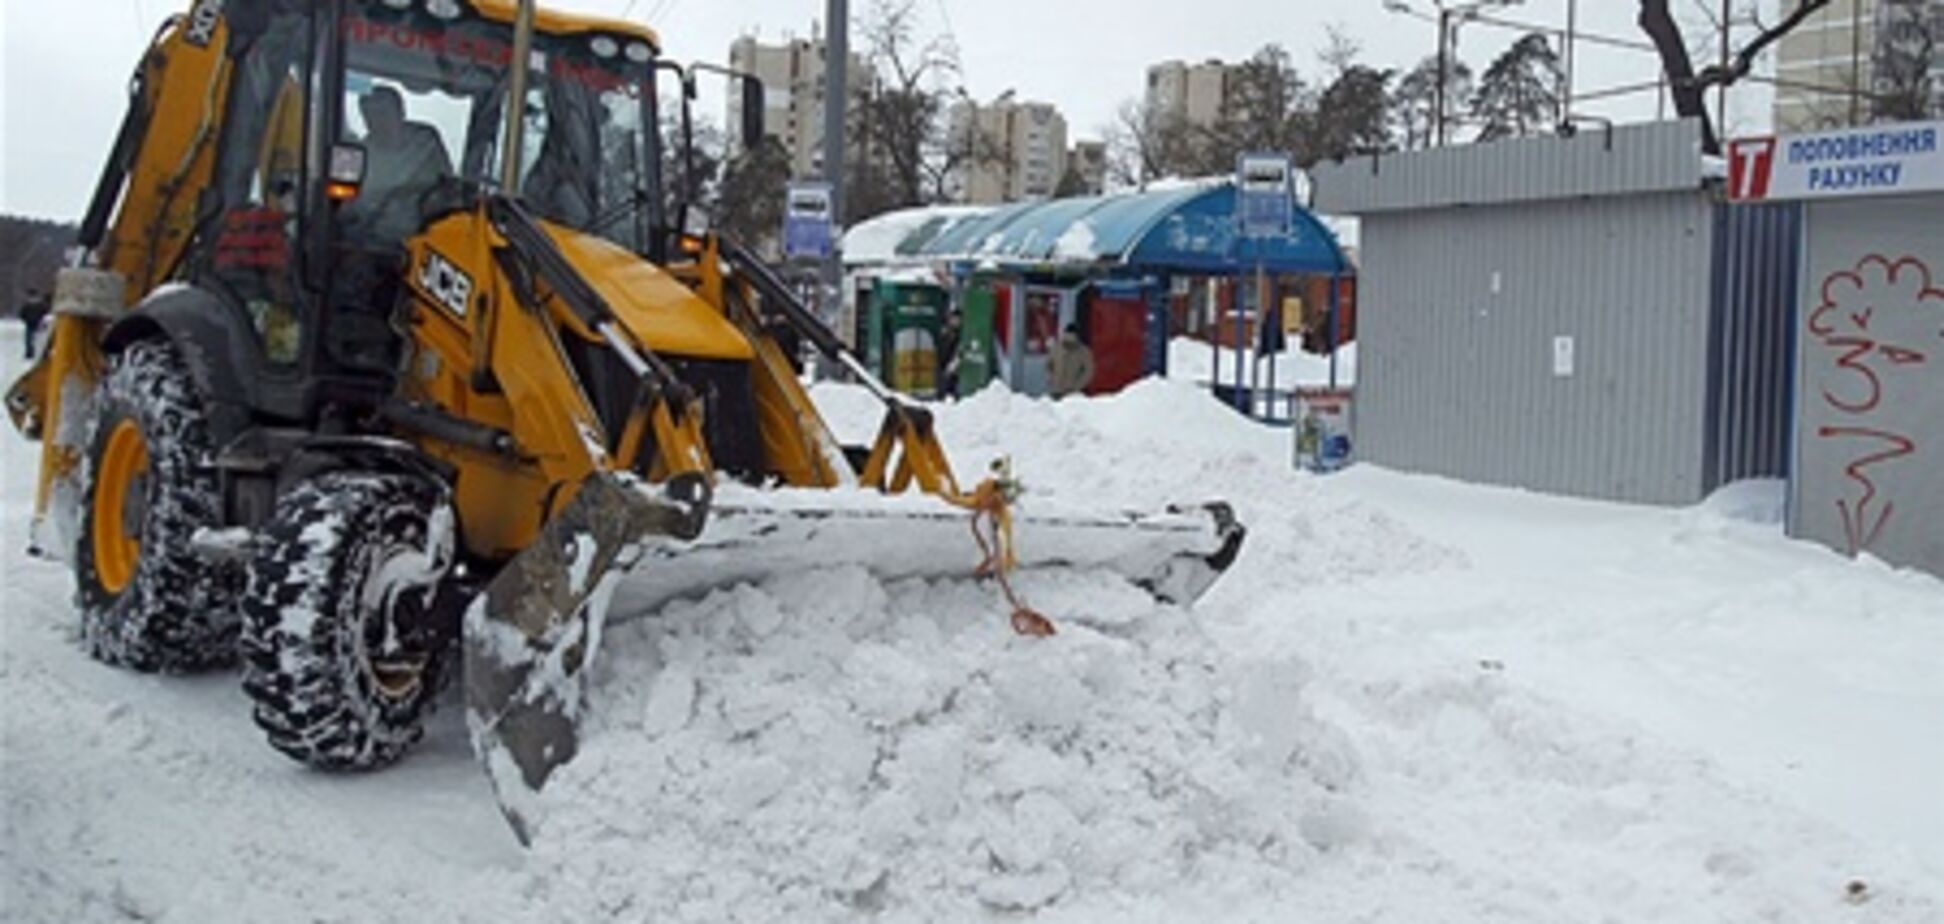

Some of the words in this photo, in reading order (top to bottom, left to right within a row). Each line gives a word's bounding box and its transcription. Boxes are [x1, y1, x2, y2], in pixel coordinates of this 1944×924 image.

[1788, 128, 1937, 164] ПОПОВНЕННЯ
[1808, 160, 1902, 191] РАХУНКУ
[418, 252, 473, 316] JCB
